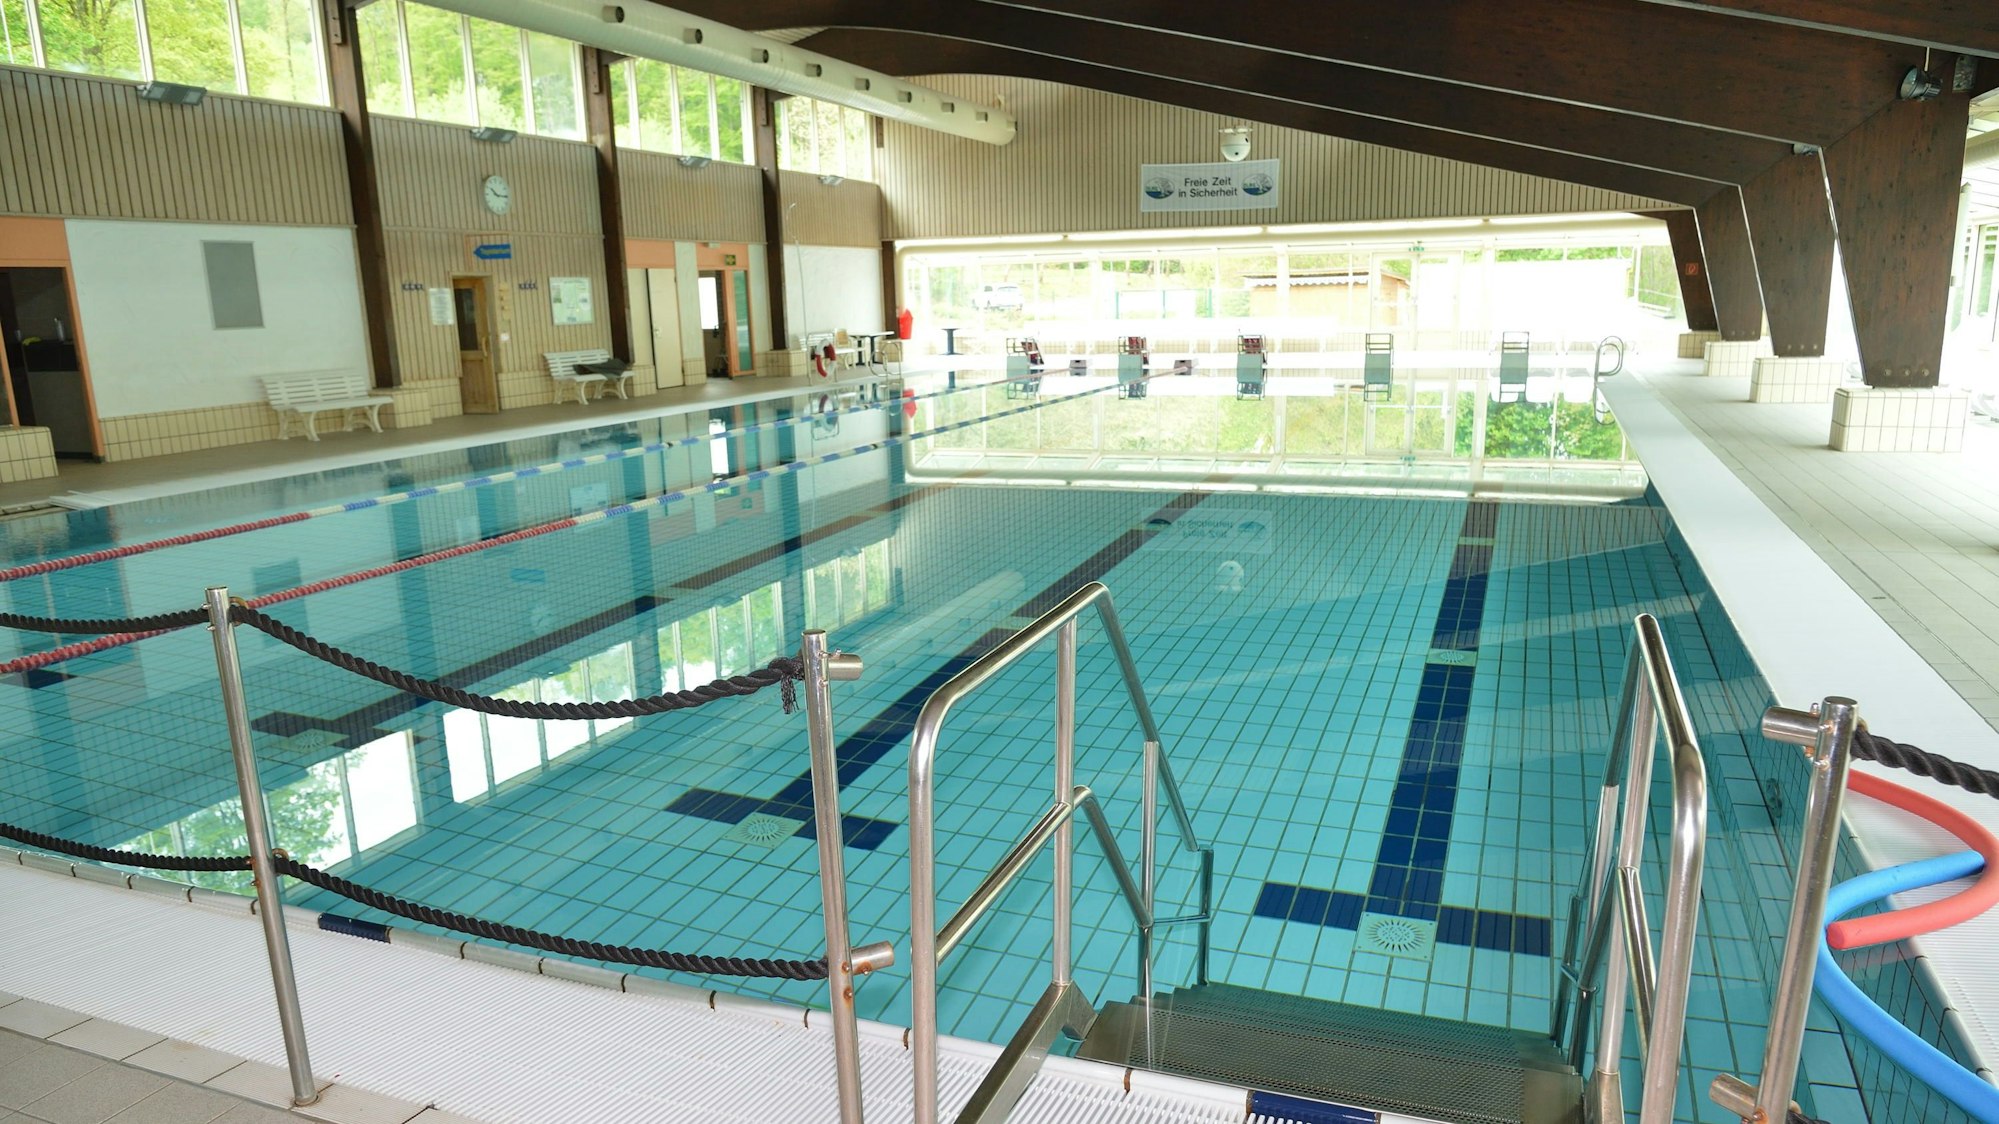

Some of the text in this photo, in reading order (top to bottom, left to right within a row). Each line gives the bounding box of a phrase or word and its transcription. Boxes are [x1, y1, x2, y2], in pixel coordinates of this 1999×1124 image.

[1184, 176, 1231, 187] Freie Zeit
[1178, 187, 1238, 198] in Sicherheit
